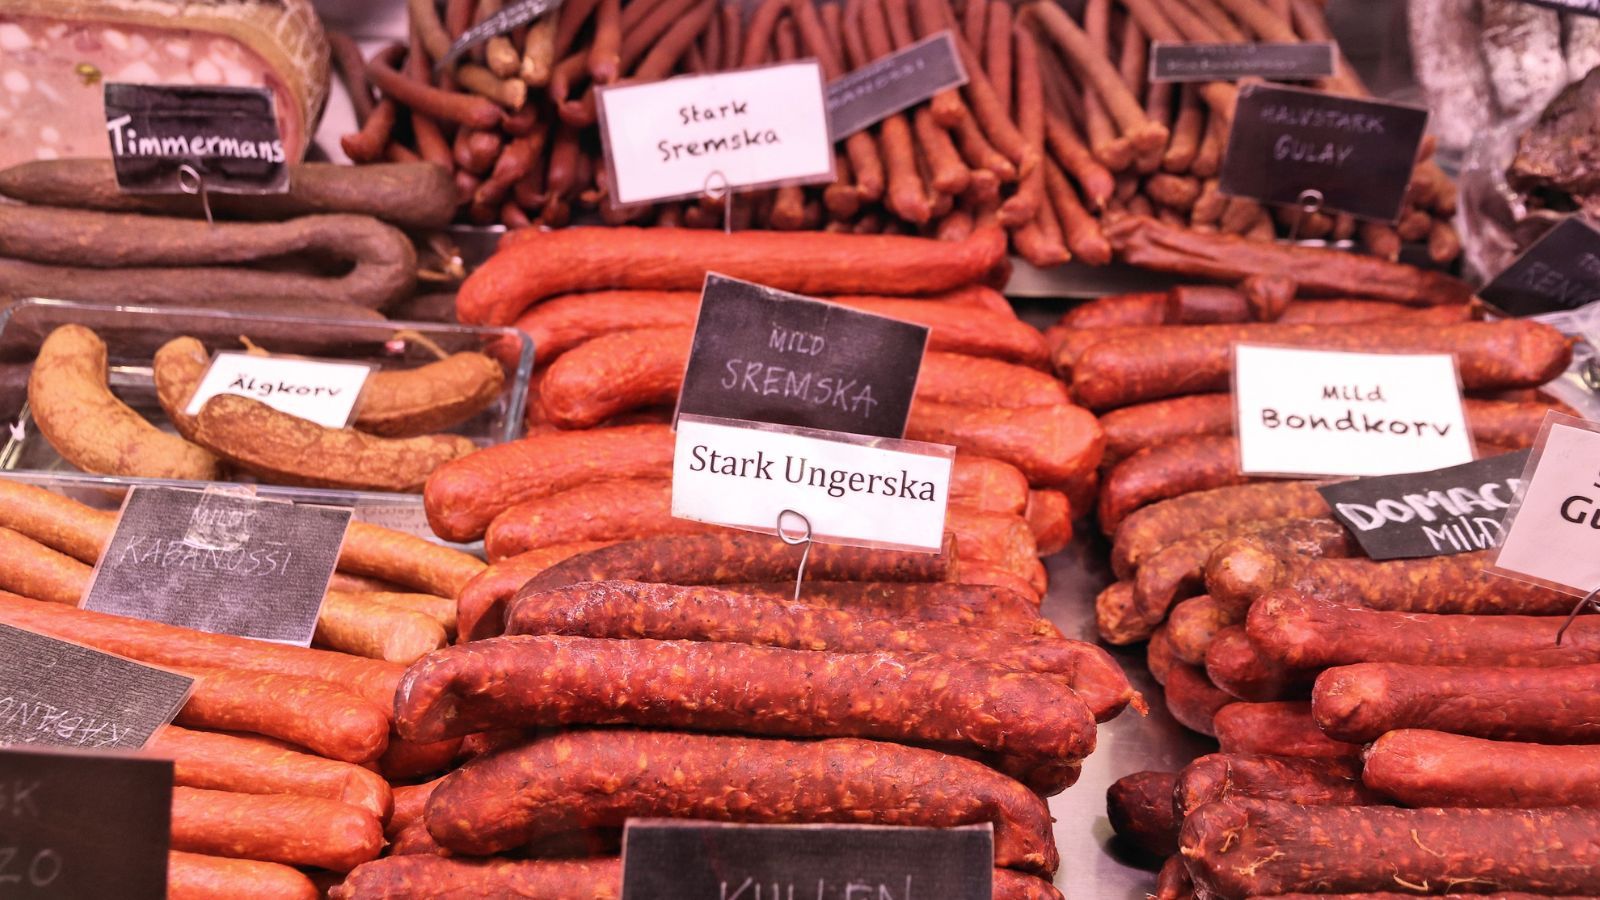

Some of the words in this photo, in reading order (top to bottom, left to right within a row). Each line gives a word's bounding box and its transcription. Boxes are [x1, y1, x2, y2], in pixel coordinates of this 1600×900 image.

[678, 99, 750, 125] Stark
[106, 114, 285, 163] Timmermans
[657, 128, 781, 162] Sremska
[768, 328, 826, 357] MILD
[228, 373, 343, 397] Älgkorv
[721, 358, 879, 419] SREMSKA
[1322, 384, 1386, 402] Mild
[1262, 408, 1451, 437] Bondkorv
[689, 444, 775, 481] Stark
[784, 455, 936, 502] Ungerska
[1422, 516, 1507, 551] MILD
[120, 535, 292, 577] KABANOSSI
